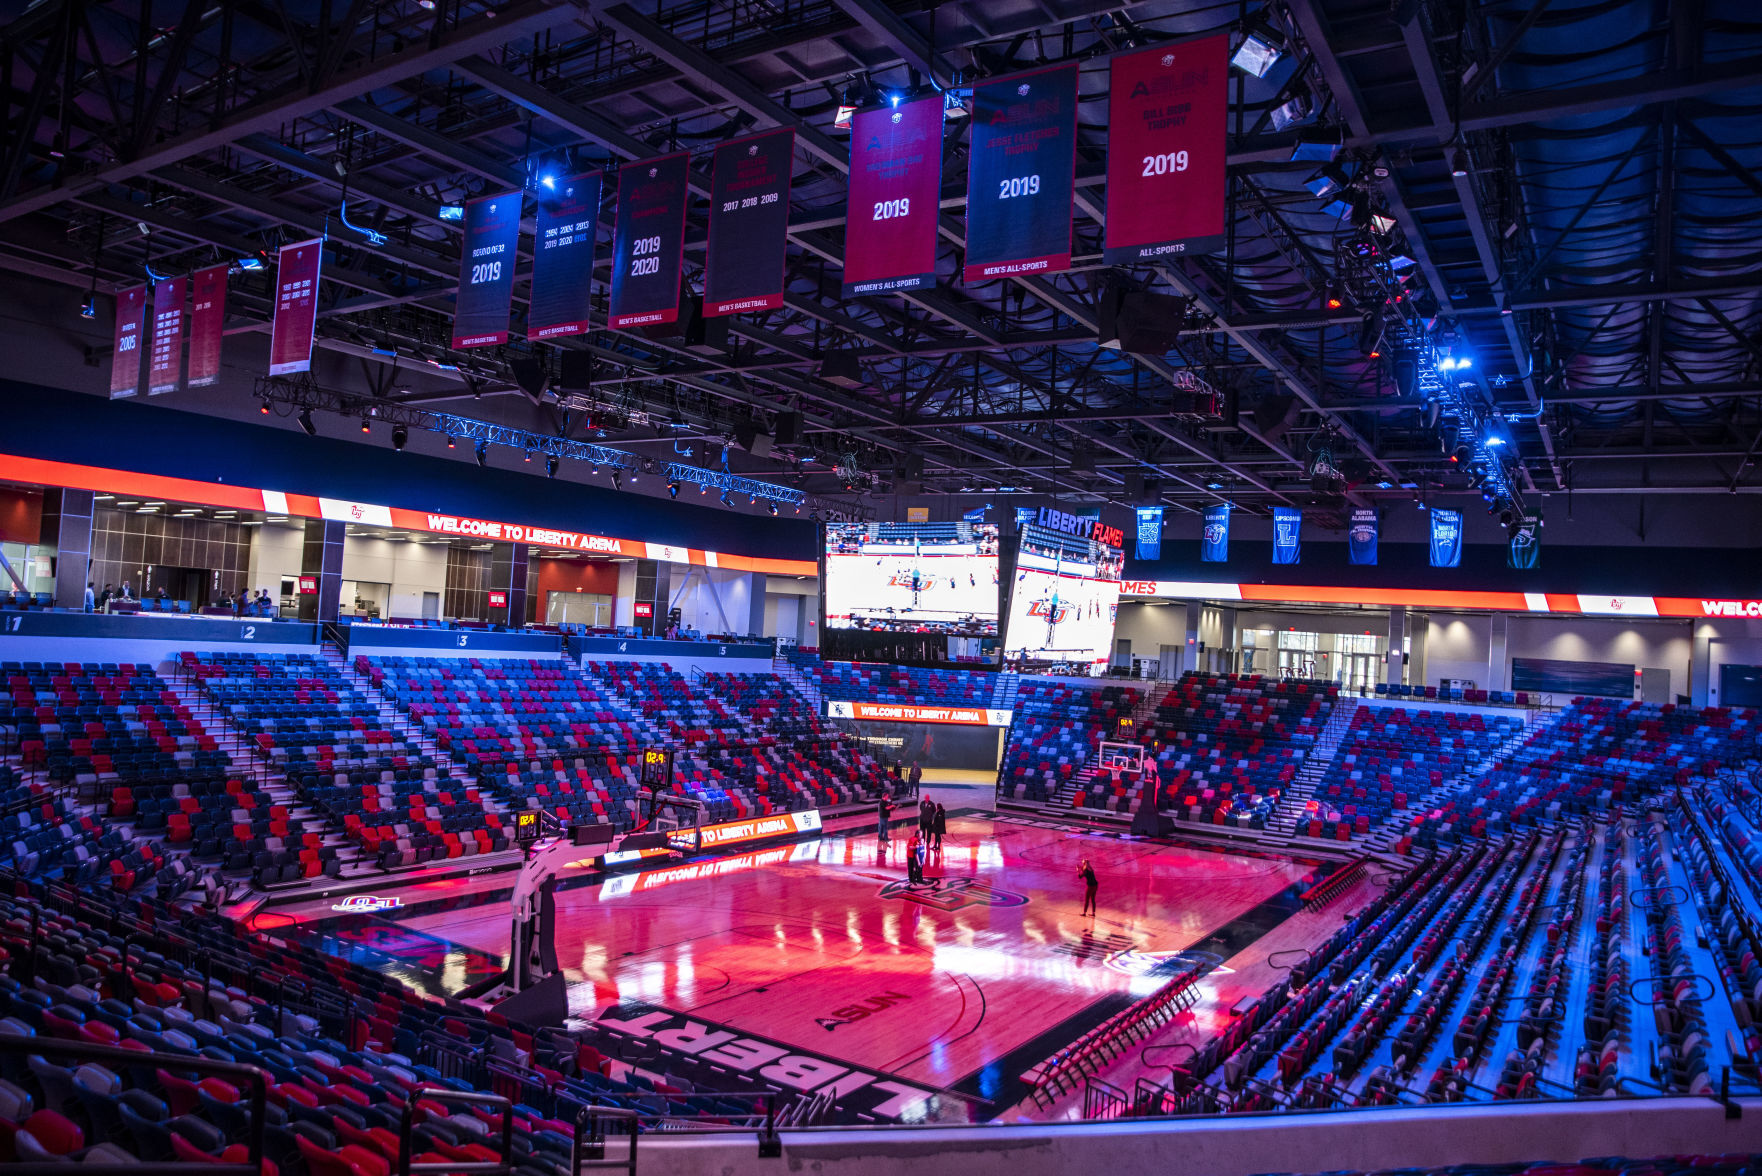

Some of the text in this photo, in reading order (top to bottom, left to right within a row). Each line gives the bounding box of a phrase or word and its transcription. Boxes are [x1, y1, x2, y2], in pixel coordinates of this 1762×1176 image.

[1143, 109, 1164, 121] BILL
[1147, 116, 1187, 131] TROPHY
[1005, 142, 1040, 156] TROPHY
[1141, 150, 1189, 177] 2019
[999, 174, 1040, 200] 2019
[723, 192, 778, 212] 2017 2018 2009
[872, 197, 910, 221] 2019
[575, 220, 590, 231] 2013
[544, 239, 558, 249] 2019
[558, 235, 573, 246] 2020
[632, 236, 661, 256] 2019
[1139, 243, 1185, 258] ALL-SPORTS
[471, 261, 502, 285] 2019
[631, 256, 659, 277] 2020
[984, 260, 1048, 275] MEN'S ALL-SPORTS
[854, 277, 921, 293] WOMEN'S ALL-SPORTS
[718, 299, 768, 313] MEN'S BASKETBALL
[618, 313, 663, 326] MEN'S BASKETBALL
[551, 324, 579, 334] BASKETBALL
[119, 334, 137, 352] 2005
[427, 514, 622, 553] WELCOME TO LIBERTY ARENA
[1038, 506, 1124, 548] LIBERTY FLAMES
[244, 625, 256, 639] 2
[459, 635, 468, 646] 3
[619, 641, 627, 652] 4
[720, 646, 727, 656] 5
[860, 705, 980, 722] WELCOME TO LIBERTY ARENA
[703, 831, 716, 843] TO
[717, 823, 755, 842] LIBERTY
[757, 818, 788, 835] ARENA
[815, 991, 912, 1031] ASUN
